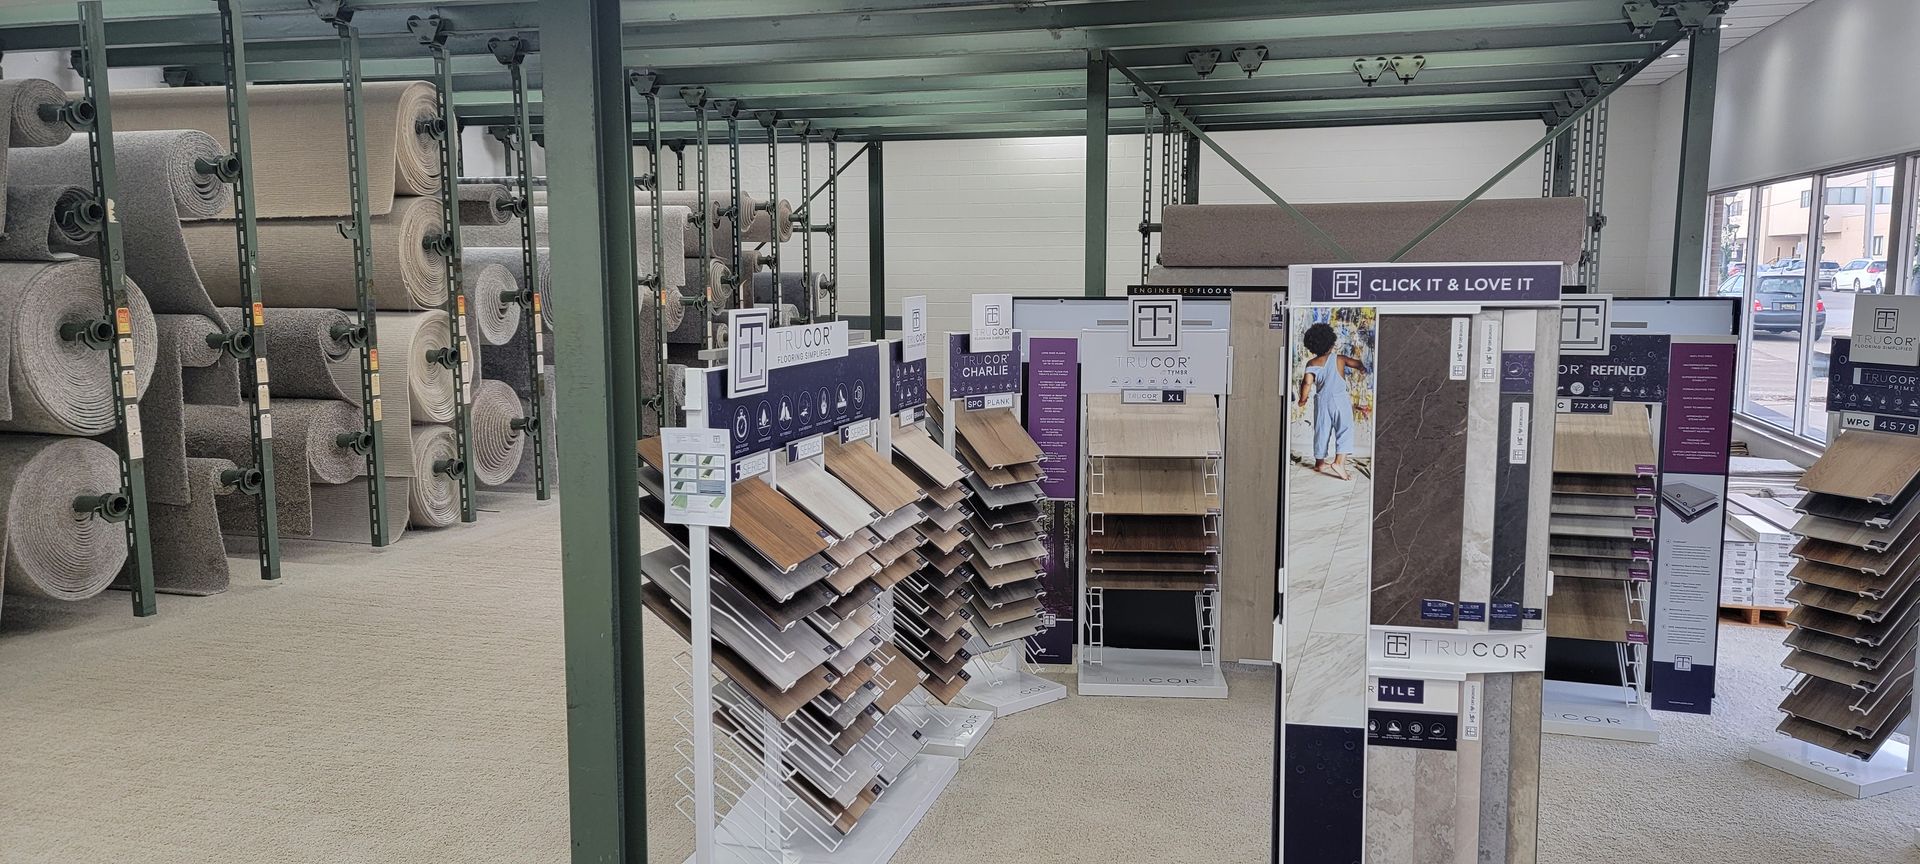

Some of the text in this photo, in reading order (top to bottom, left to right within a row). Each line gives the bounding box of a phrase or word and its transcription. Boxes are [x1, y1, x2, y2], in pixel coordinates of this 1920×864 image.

[112, 248, 120, 261] 3
[1370, 277, 1534, 293] CLICK IT & LOVE IT
[974, 327, 1010, 336] TRUCOR
[776, 326, 831, 351] TRUCOR
[1856, 334, 1914, 347] TRUCOR
[777, 348, 831, 364] FLOORING SIMPLIFIED
[962, 353, 1008, 366] TRUCOR
[1115, 356, 1188, 369] TRUCOR
[962, 364, 1009, 378] CHARLIE
[1590, 365, 1647, 376] REFINED
[1864, 372, 1916, 385] TRUCOR
[1888, 384, 1915, 392] PRIME
[967, 397, 1010, 408] SPC PLANK
[1168, 393, 1181, 401] XL
[1573, 402, 1590, 410] 7.72
[1598, 402, 1608, 410] 48
[850, 424, 869, 438] SERIES
[1846, 417, 1916, 433] WPC 4579
[800, 441, 821, 458] SERIES
[734, 457, 767, 481] 5 SERIES
[1420, 638, 1528, 660] TRUCOR
[1380, 685, 1416, 697] TILE
